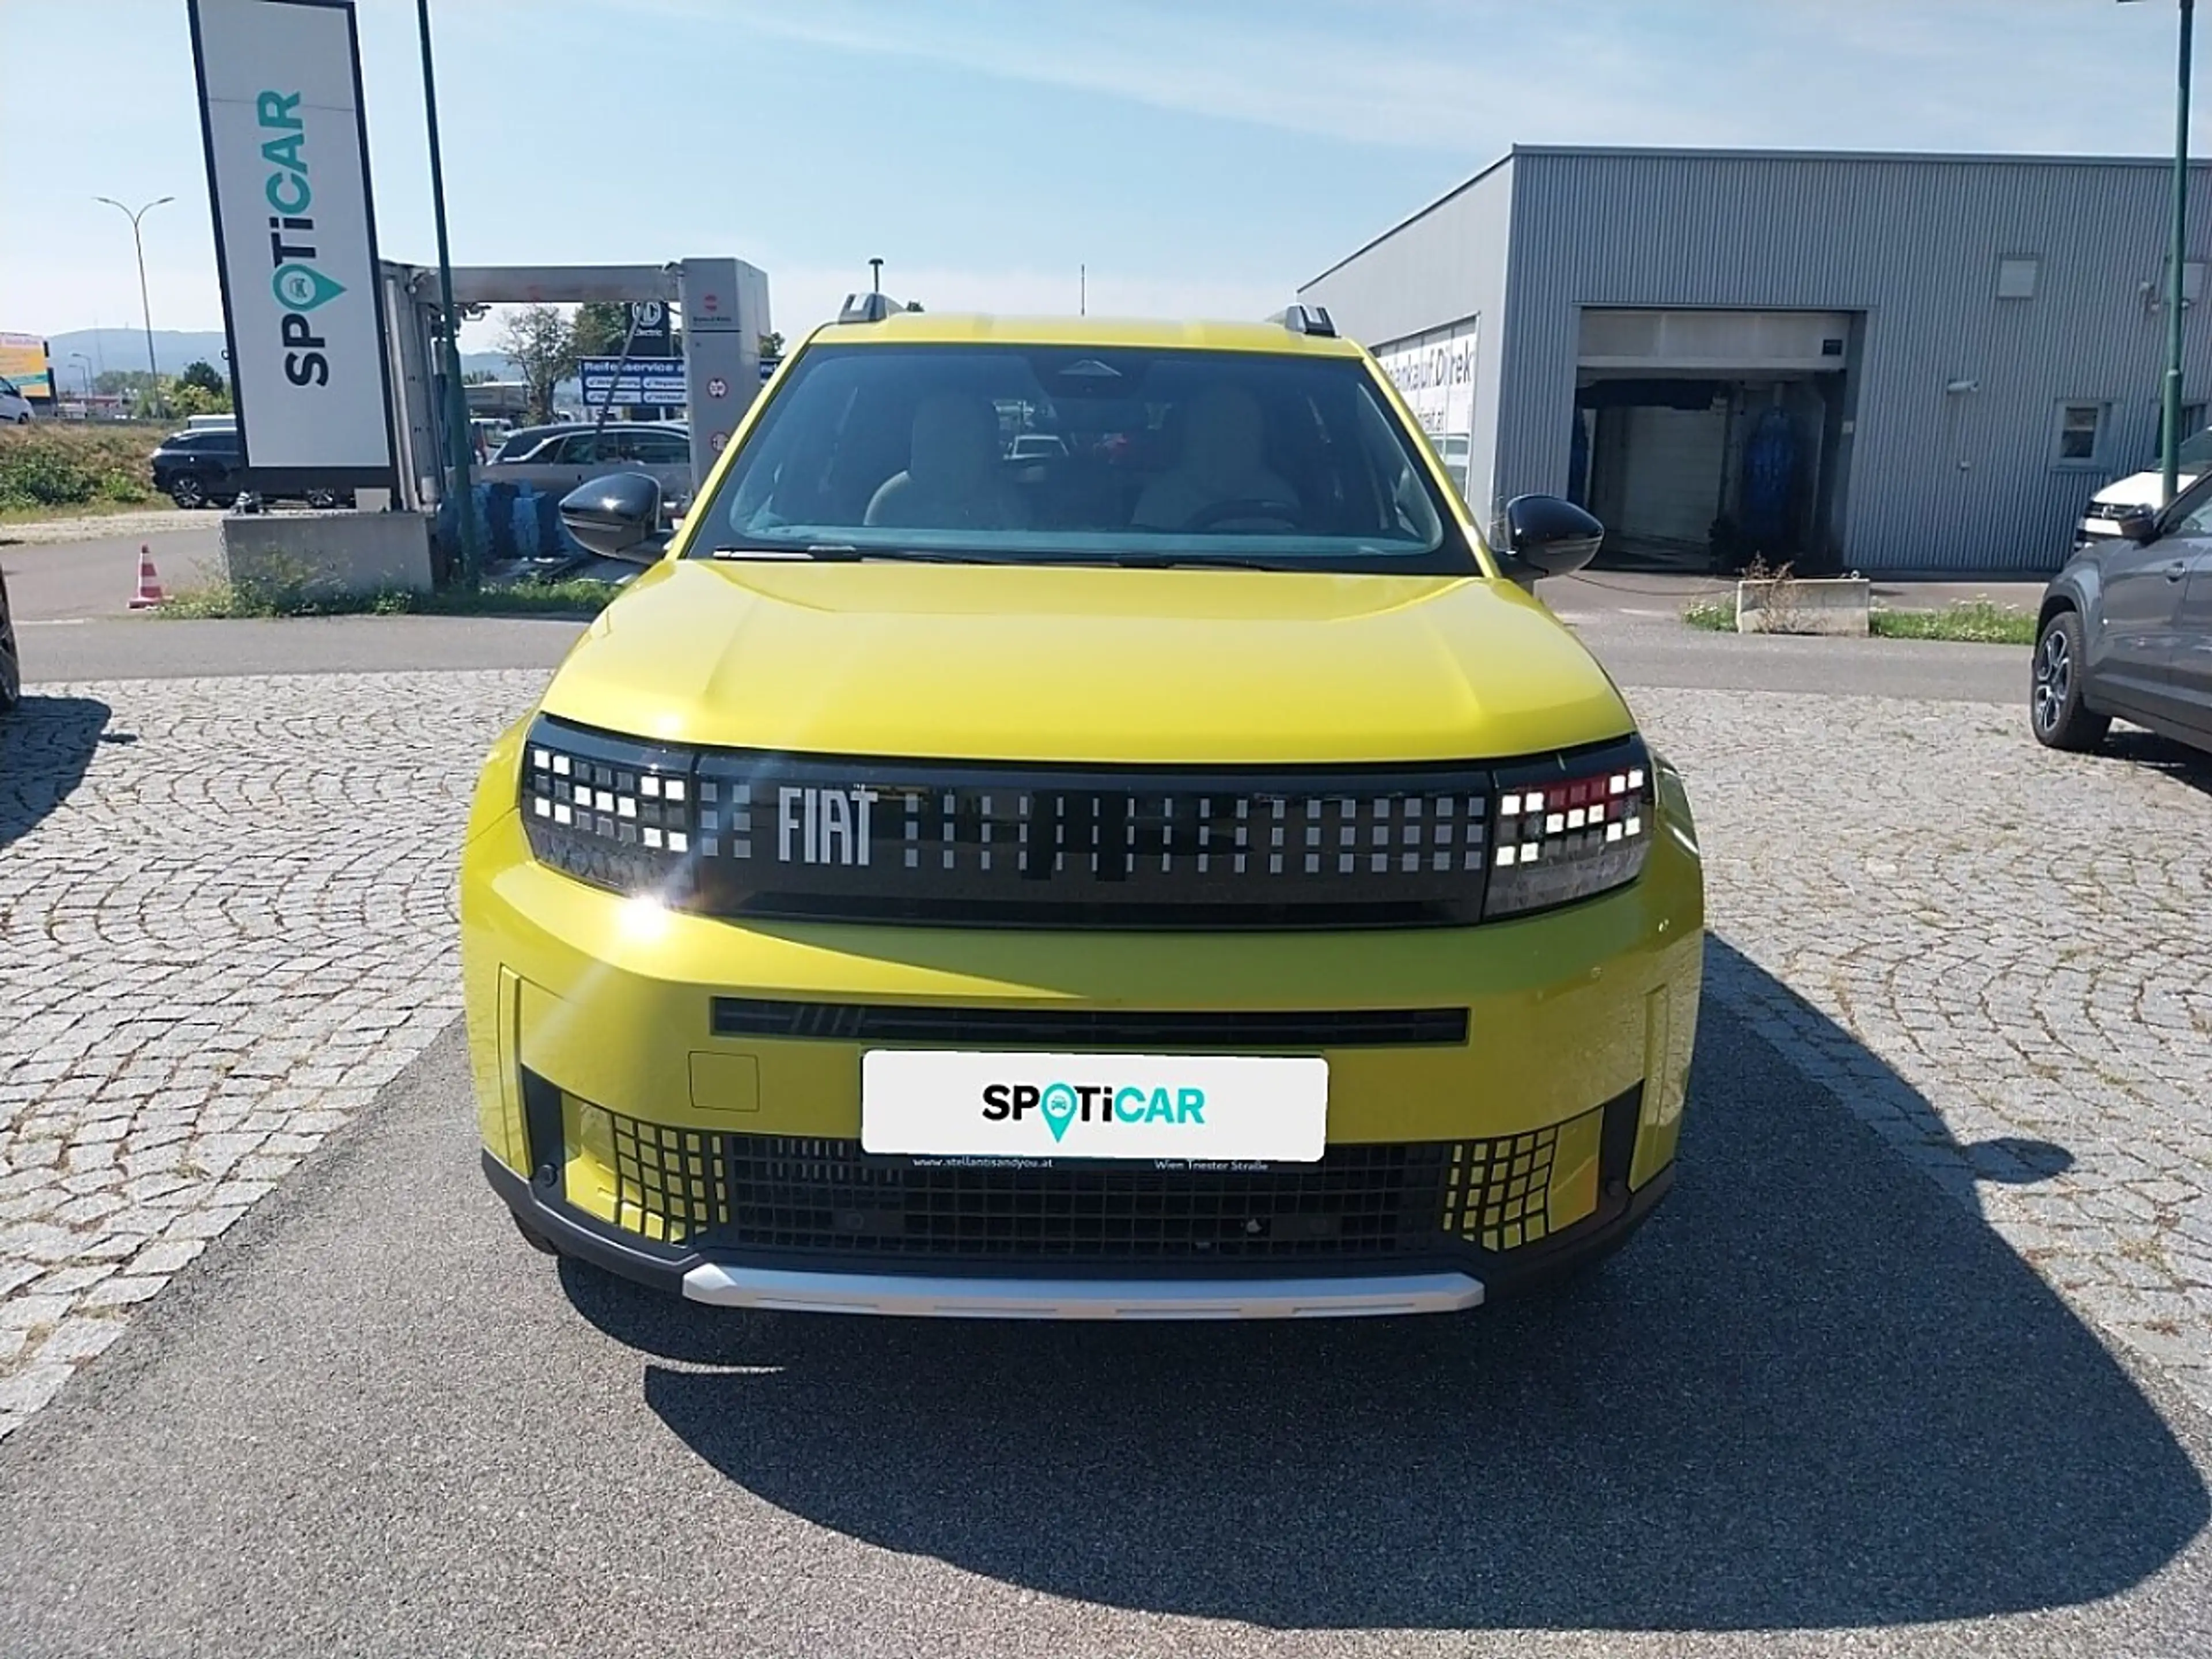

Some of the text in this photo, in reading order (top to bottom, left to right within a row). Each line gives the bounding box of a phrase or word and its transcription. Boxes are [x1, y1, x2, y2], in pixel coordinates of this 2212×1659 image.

[584, 362, 673, 372] Reifeservice
[779, 786, 878, 865] FIAT
[913, 1156, 1053, 1169] www.stellantisandyou.at
[1154, 1159, 1184, 1170] Wien
[1231, 1160, 1270, 1172] Straße
